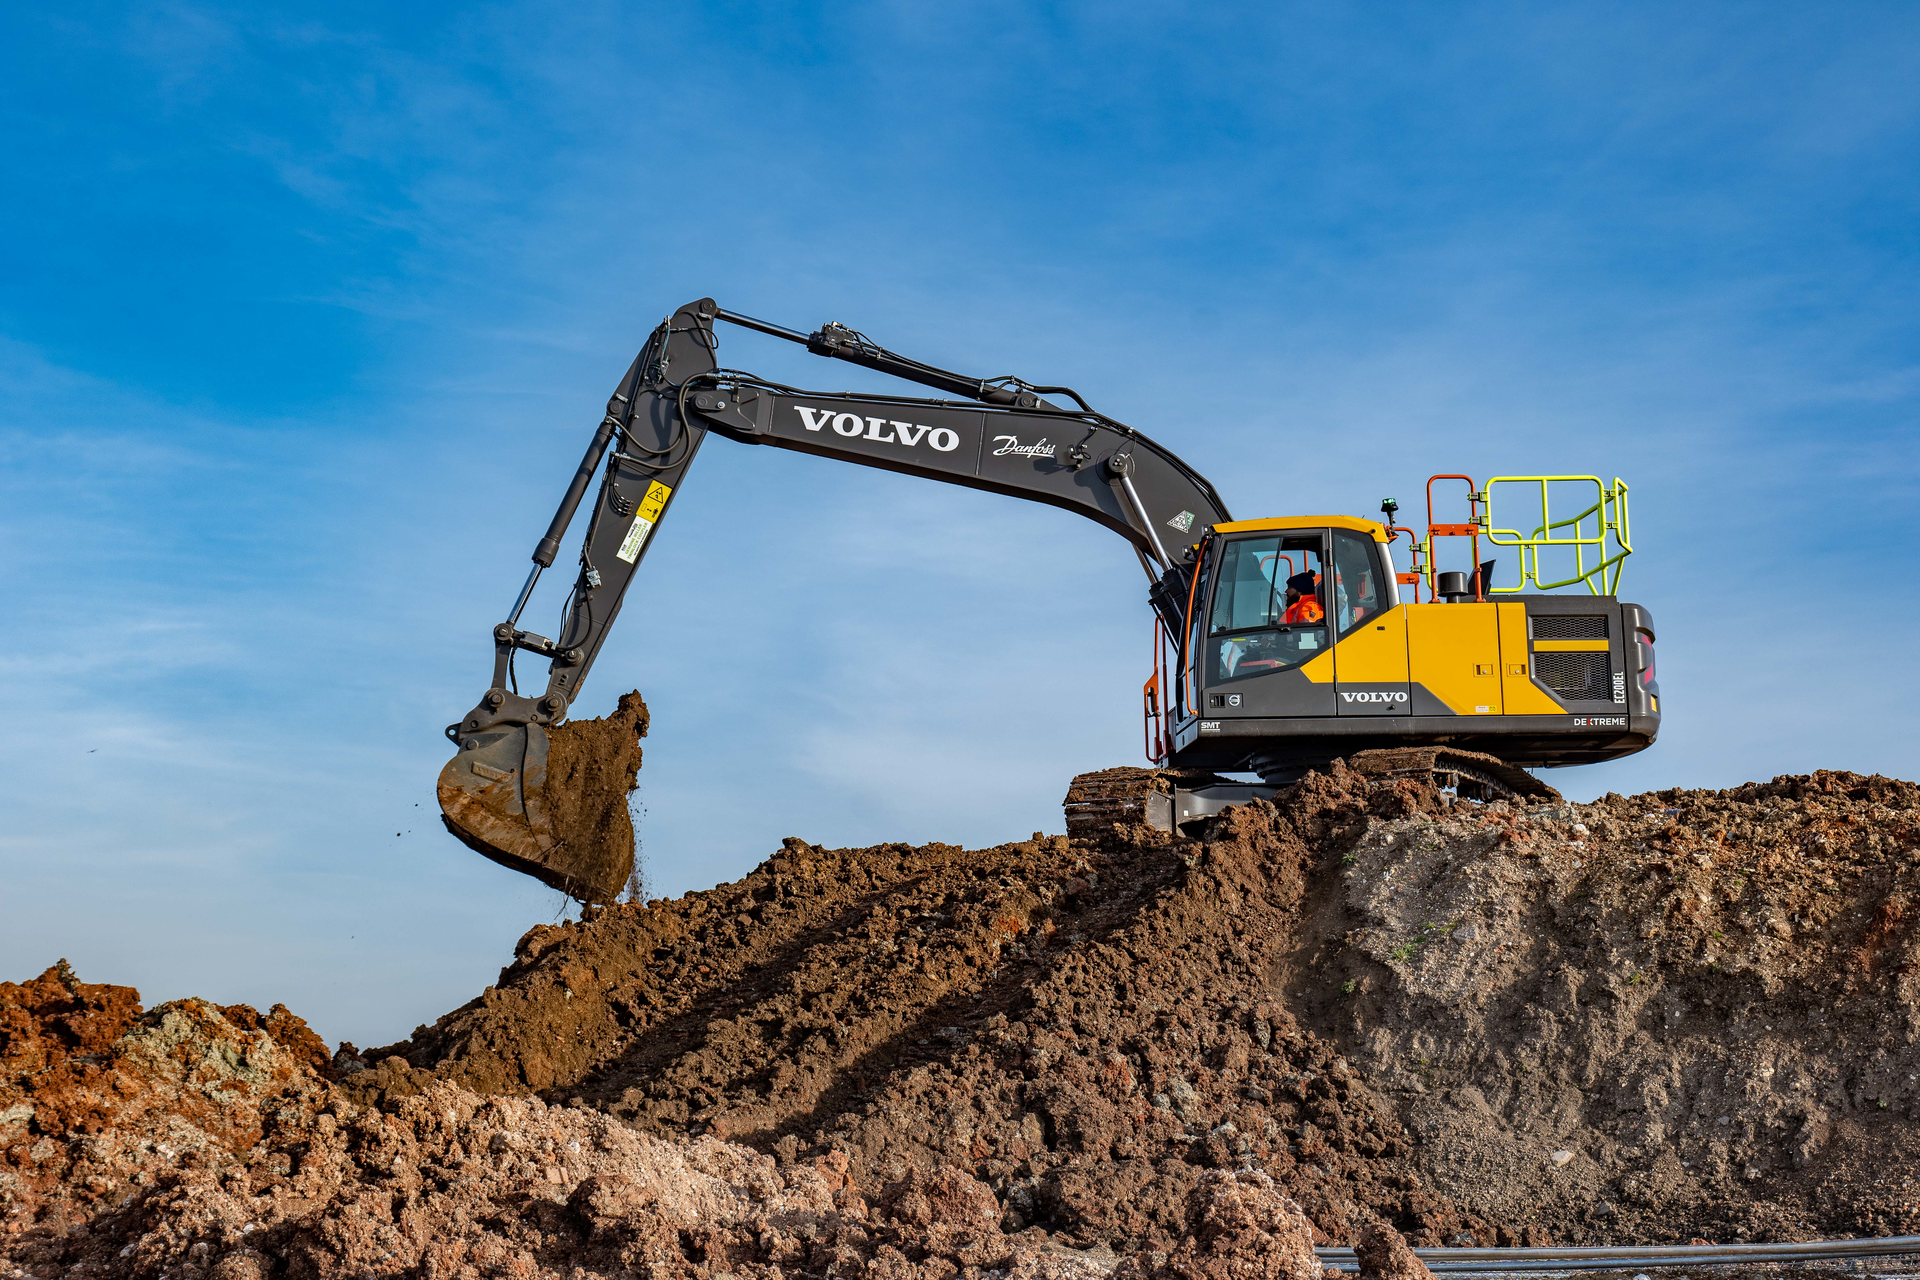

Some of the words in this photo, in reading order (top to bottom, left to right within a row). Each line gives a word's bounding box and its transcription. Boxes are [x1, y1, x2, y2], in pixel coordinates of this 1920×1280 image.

[794, 405, 960, 451] VOLVO
[993, 435, 1055, 458] Danfoss
[1341, 692, 1408, 702] VOLVO
[1613, 671, 1625, 703] EC200EL
[1574, 718, 1626, 726] DEXTREME
